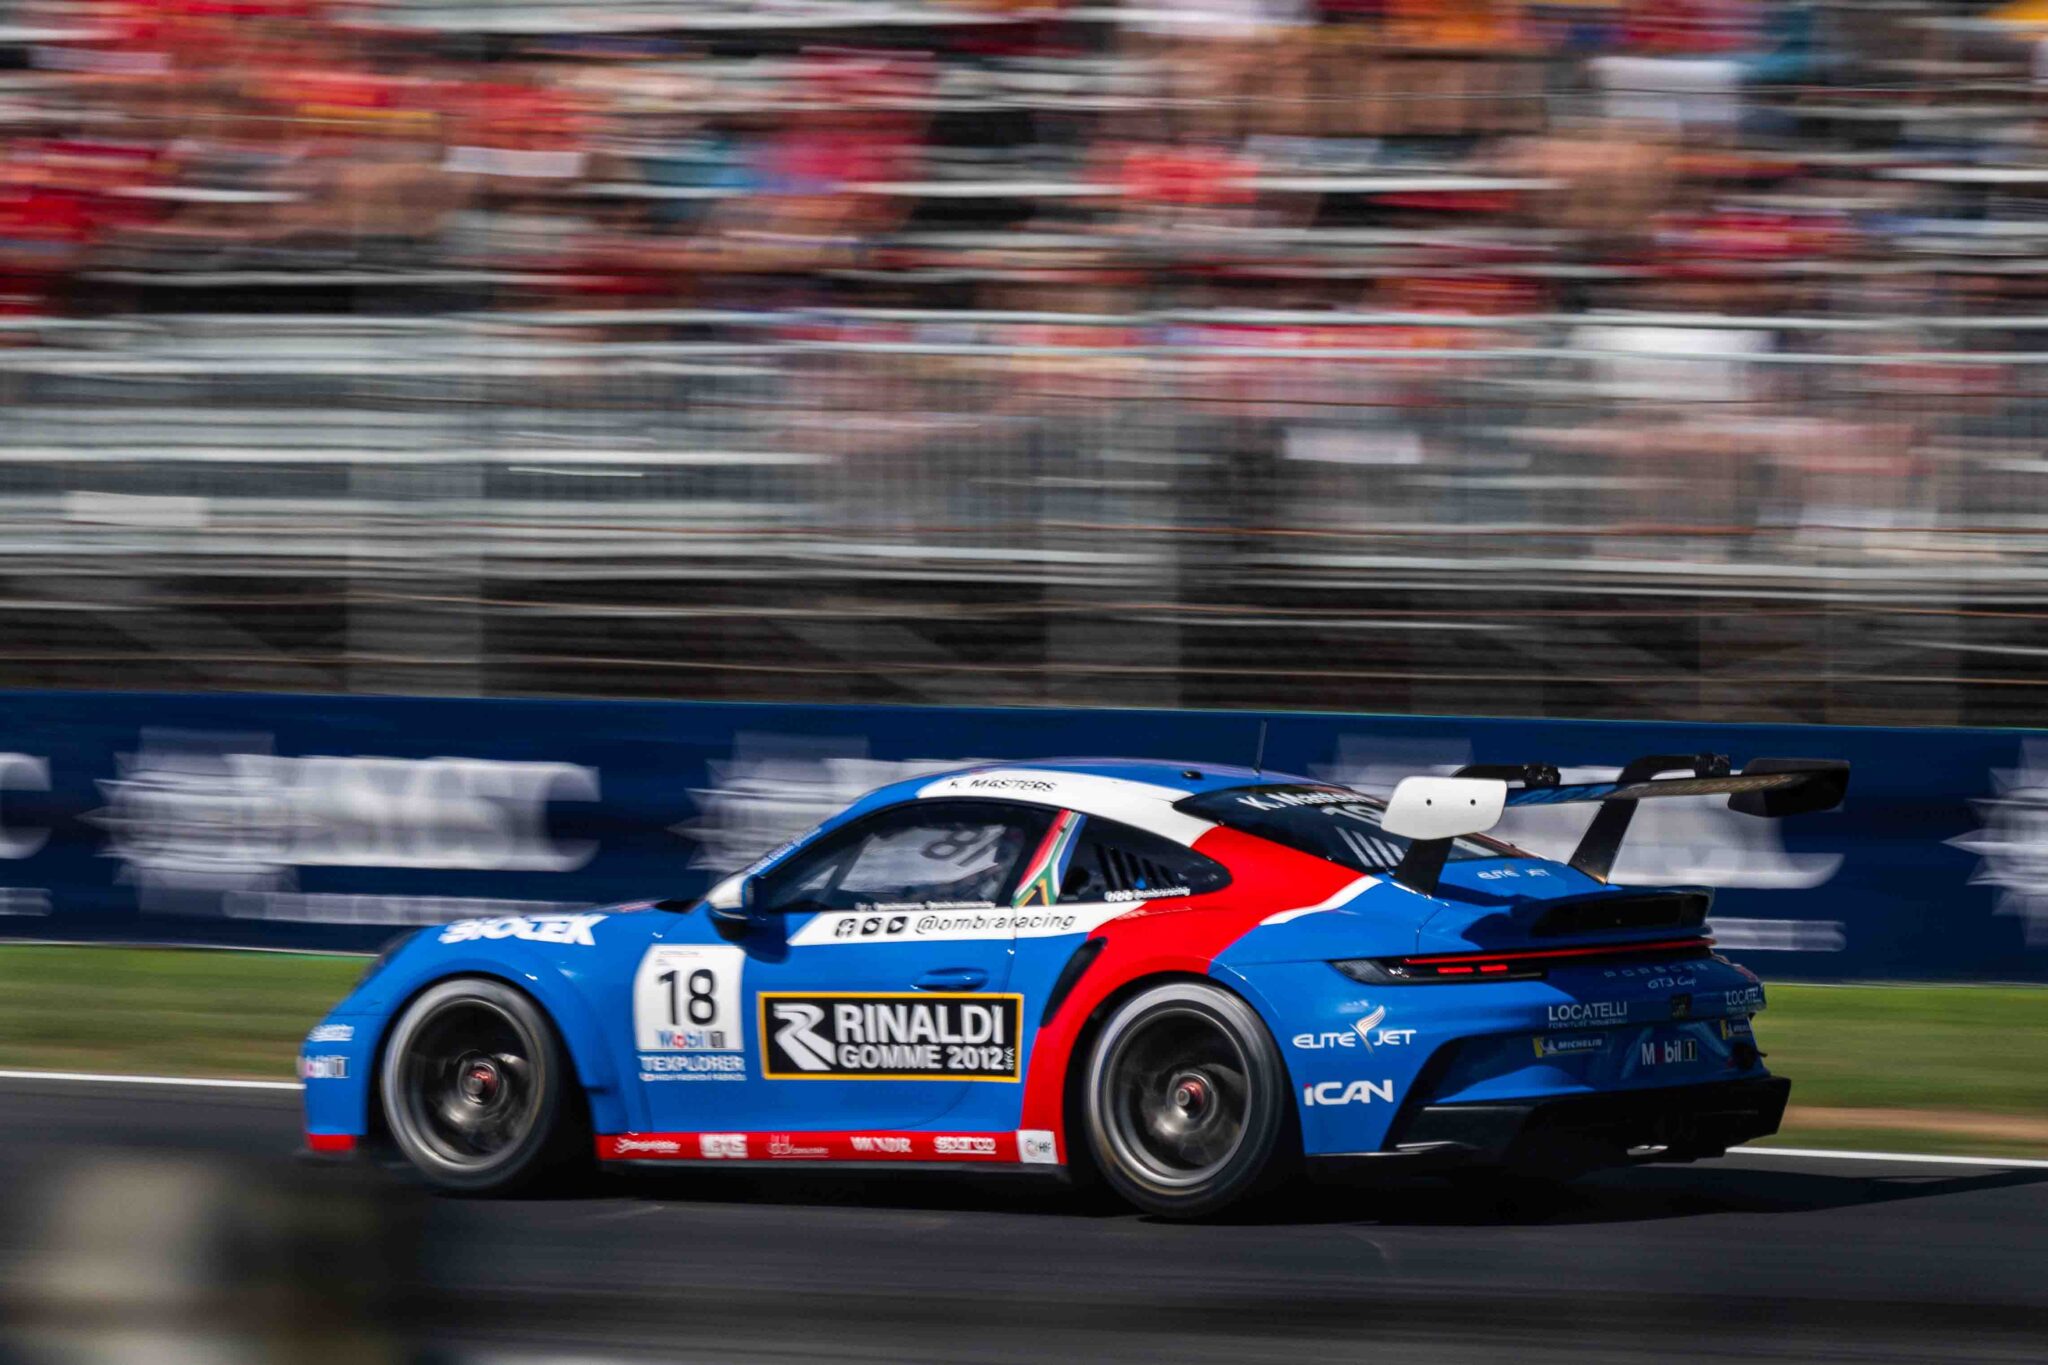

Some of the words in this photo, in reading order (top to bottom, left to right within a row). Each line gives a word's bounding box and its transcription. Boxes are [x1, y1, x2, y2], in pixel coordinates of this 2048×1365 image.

[915, 912, 1077, 935] @ombraracing
[1647, 977, 1675, 989] GT3
[1677, 976, 1697, 988] Cup
[655, 968, 719, 1027] 18
[1548, 1001, 1628, 1021] LOCATELLI
[833, 1003, 1004, 1044] RINALDI
[1292, 1032, 1356, 1049] ELITE
[1373, 1029, 1417, 1046] JET
[1557, 1039, 1603, 1051] MICHELIN
[838, 1044, 942, 1069] GOMME
[946, 1045, 1004, 1070] 2012
